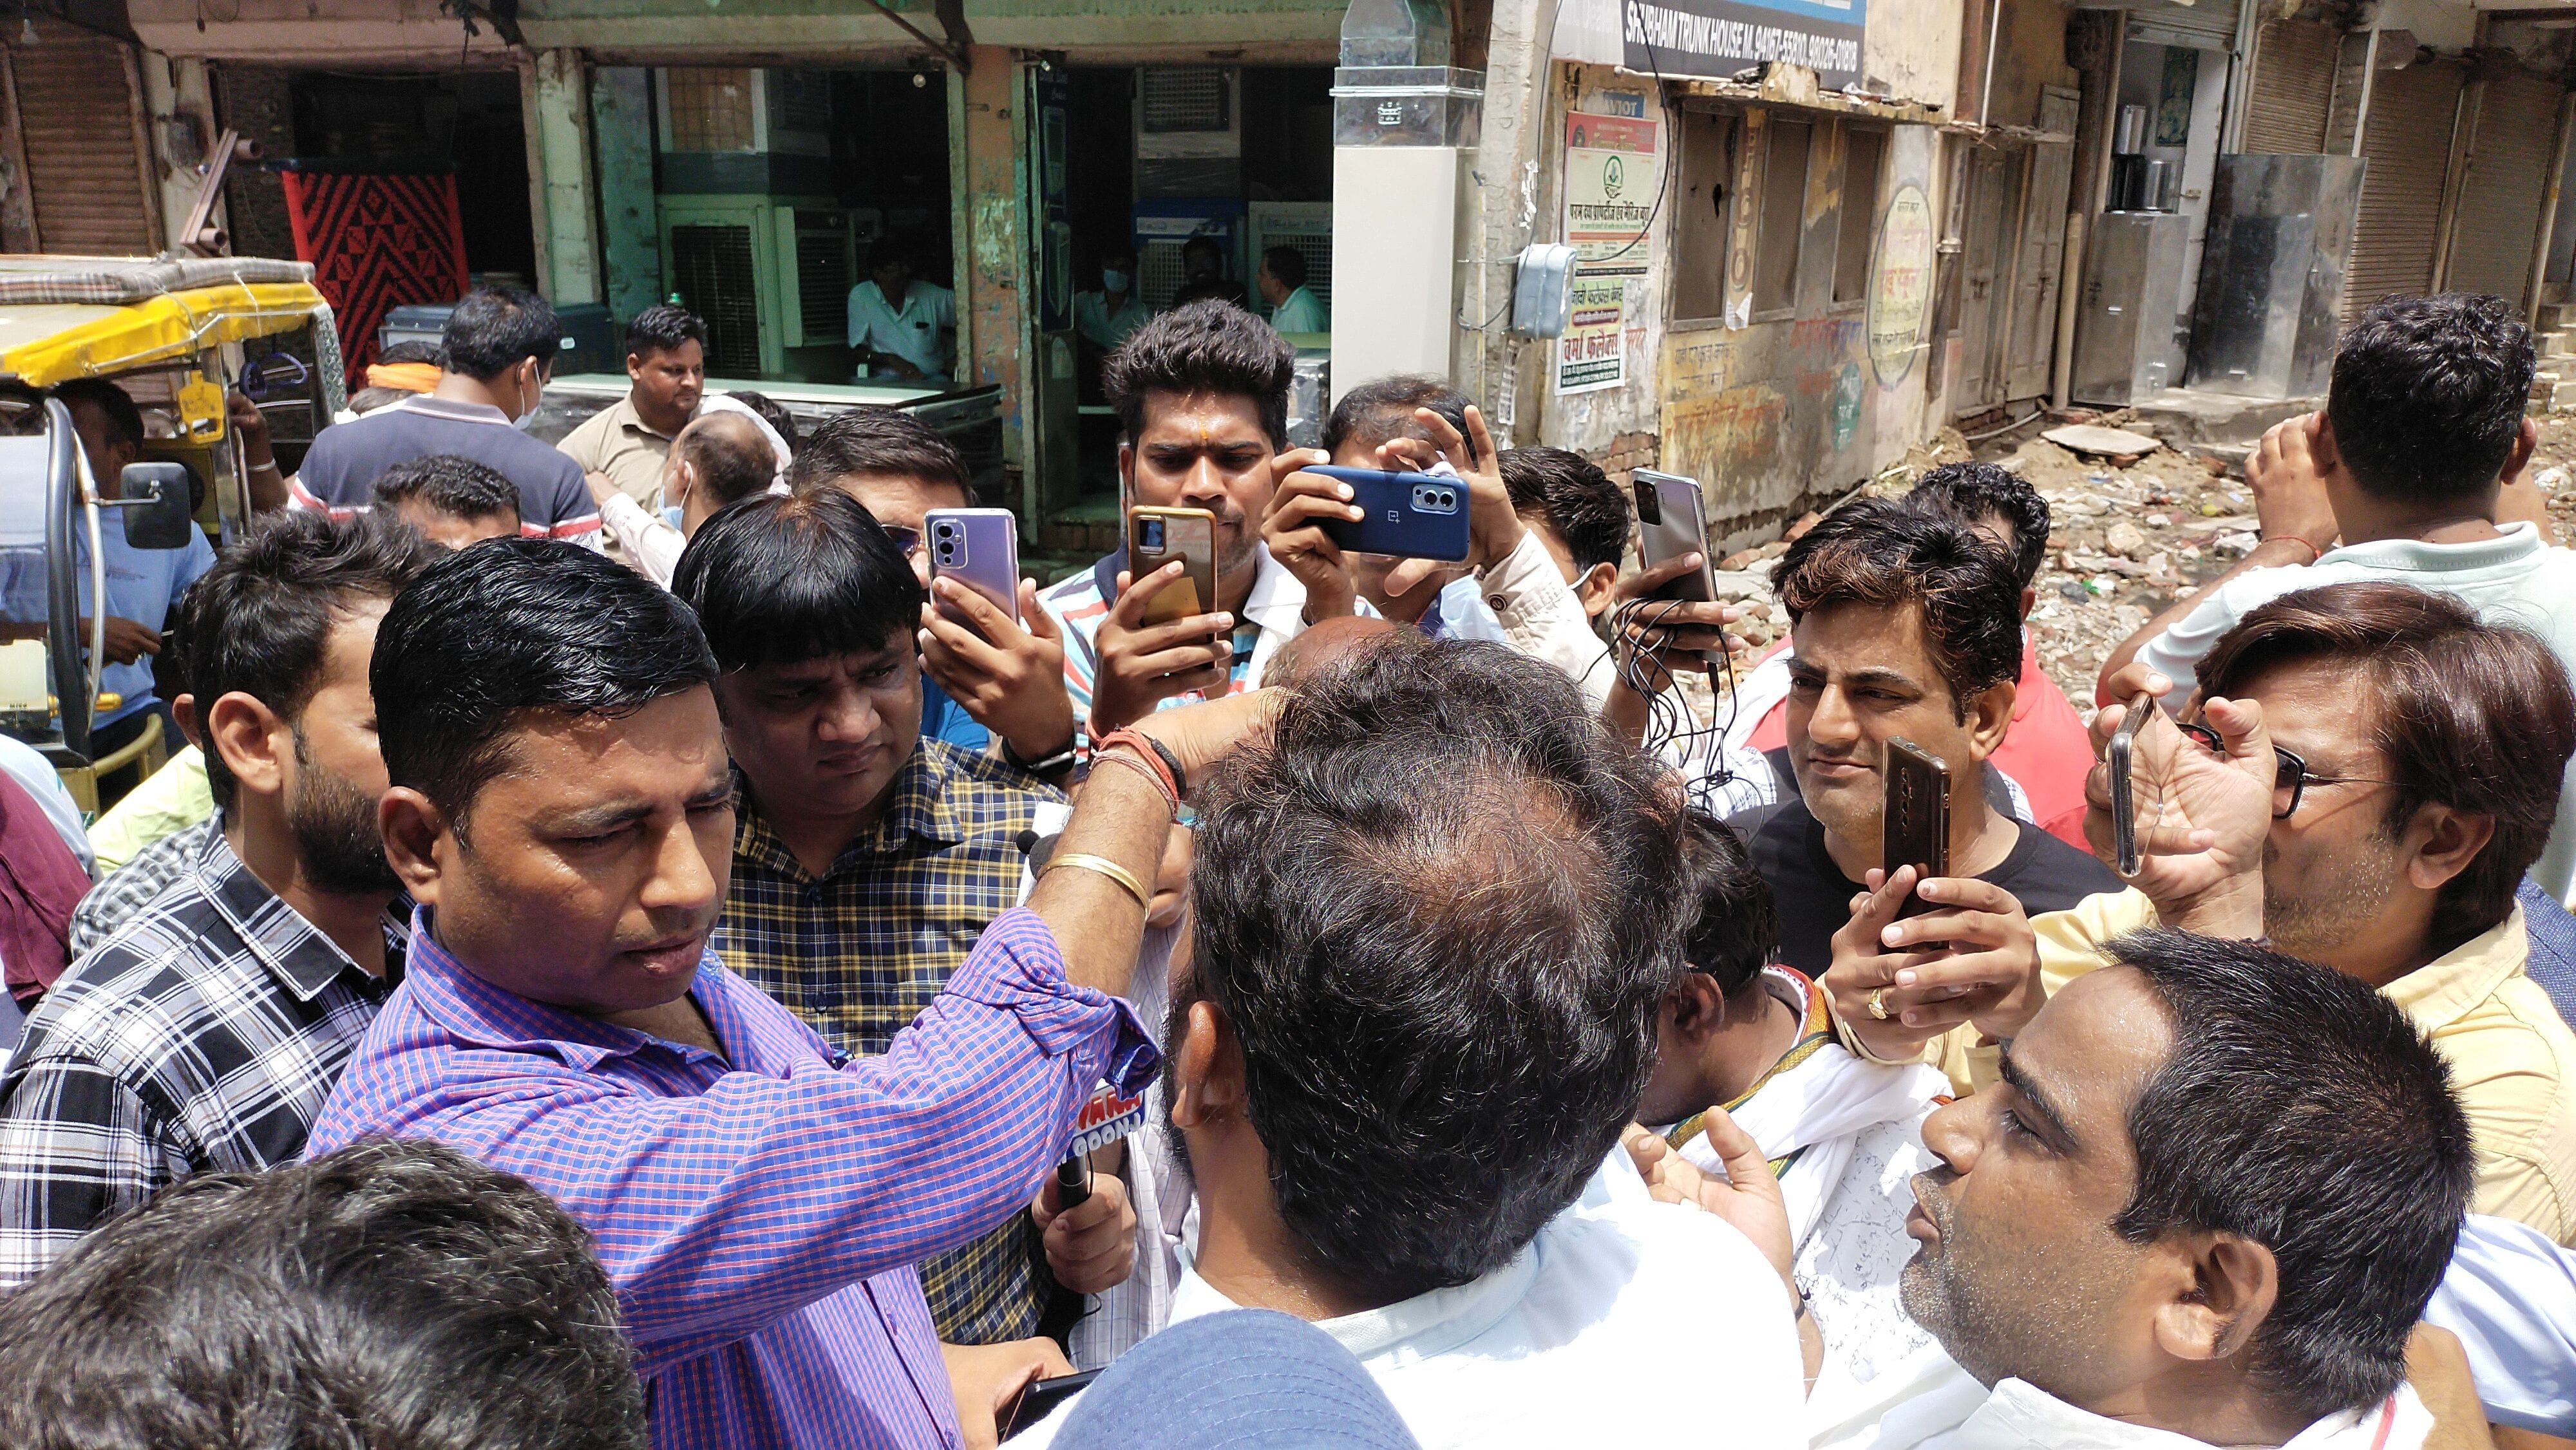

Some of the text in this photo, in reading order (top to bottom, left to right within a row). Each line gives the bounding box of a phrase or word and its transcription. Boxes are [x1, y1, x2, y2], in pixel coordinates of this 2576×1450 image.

[1625, 0, 1678, 49] SHUBHAM
[1678, 12, 1712, 55] TRUNK
[1709, 18, 1744, 59] HOUSE
